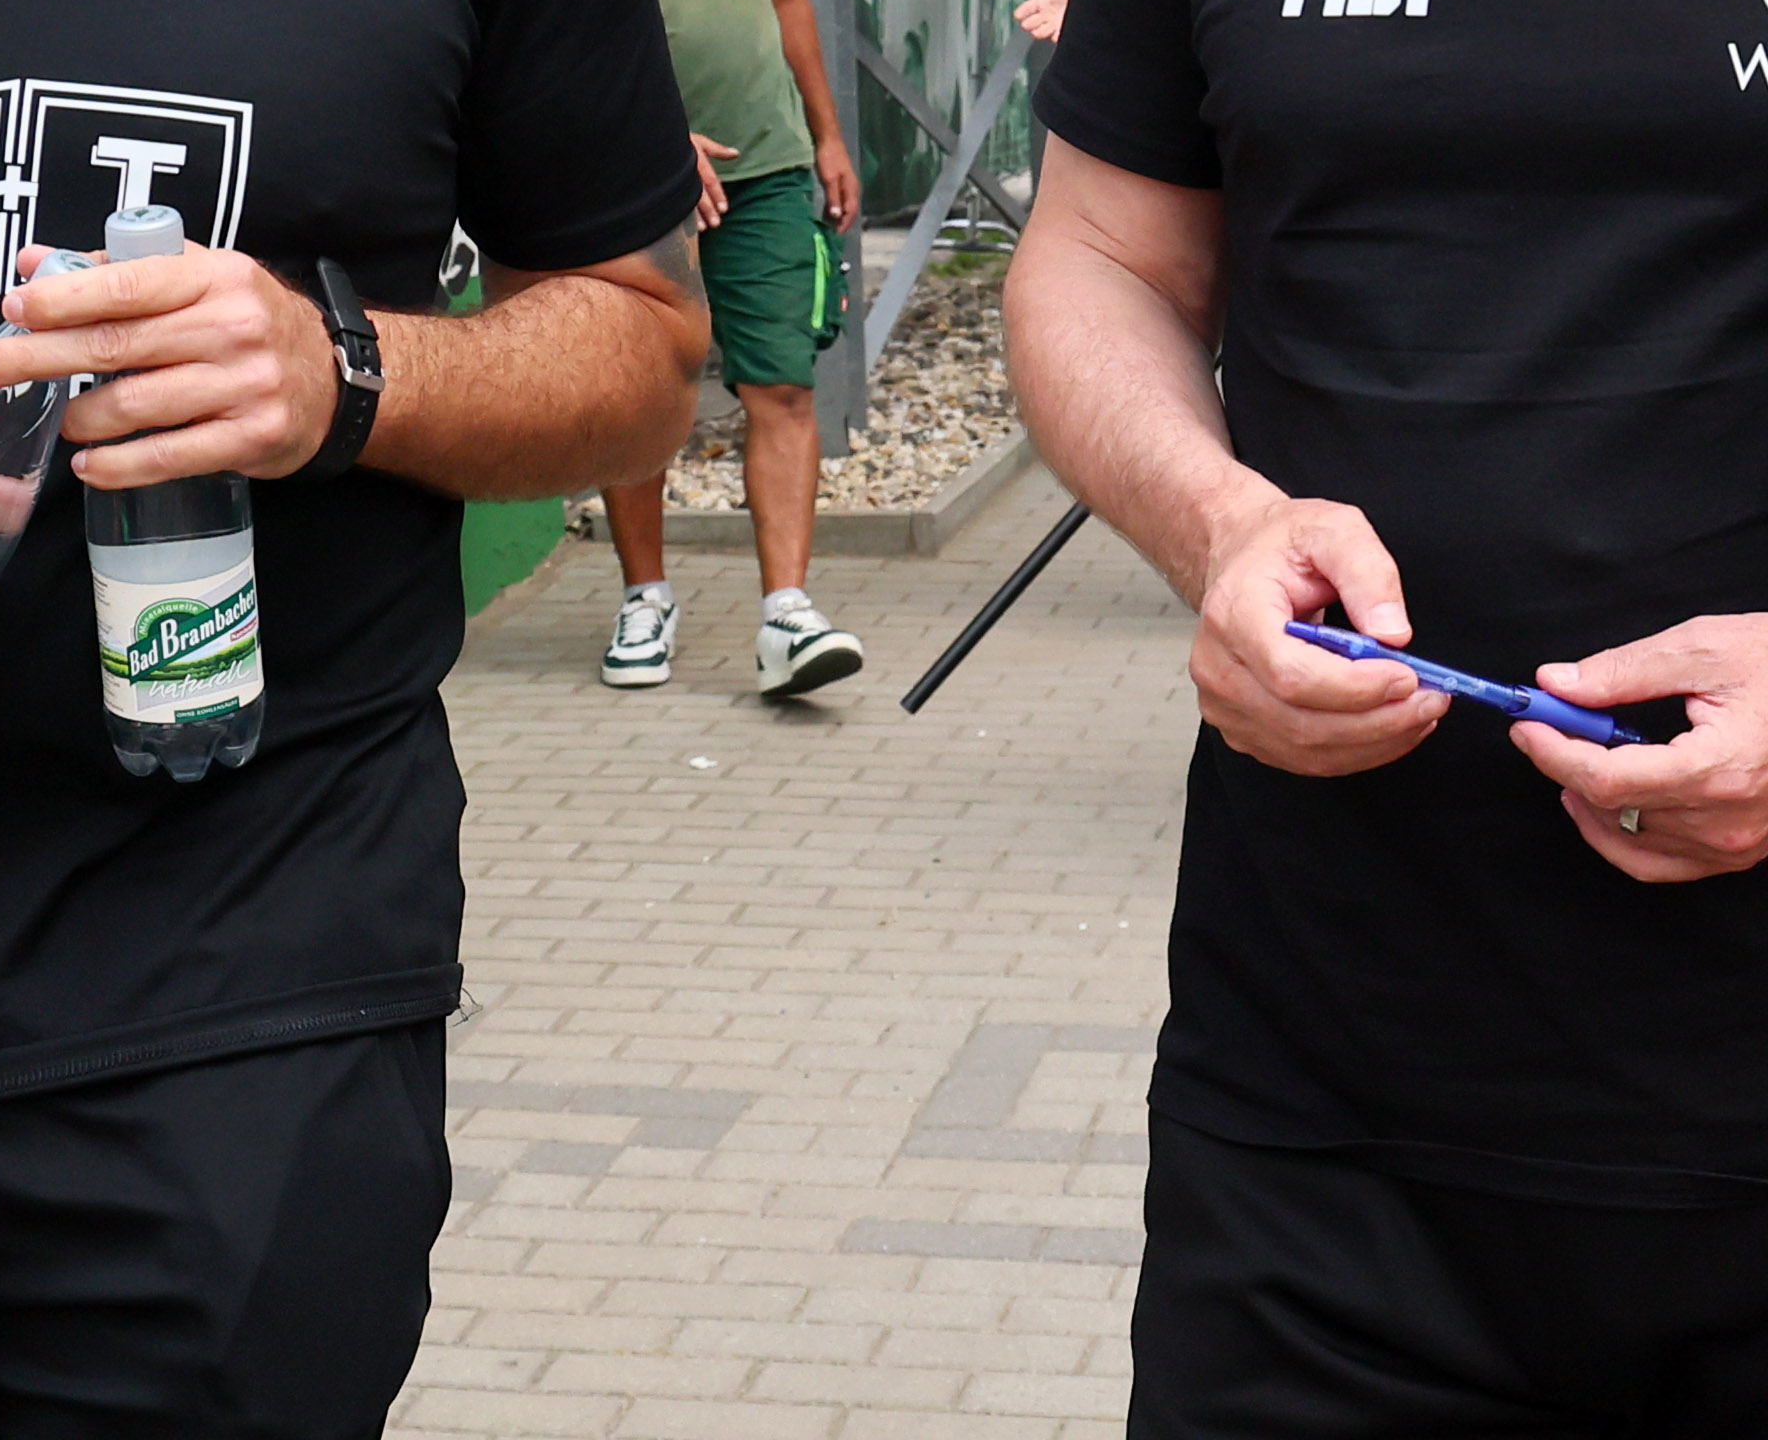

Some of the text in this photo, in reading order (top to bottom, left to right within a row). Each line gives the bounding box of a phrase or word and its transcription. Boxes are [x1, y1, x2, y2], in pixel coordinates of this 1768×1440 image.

[129, 638, 160, 677] Bad
[160, 588, 256, 660] Brambacher
[148, 659, 252, 698] naturell
